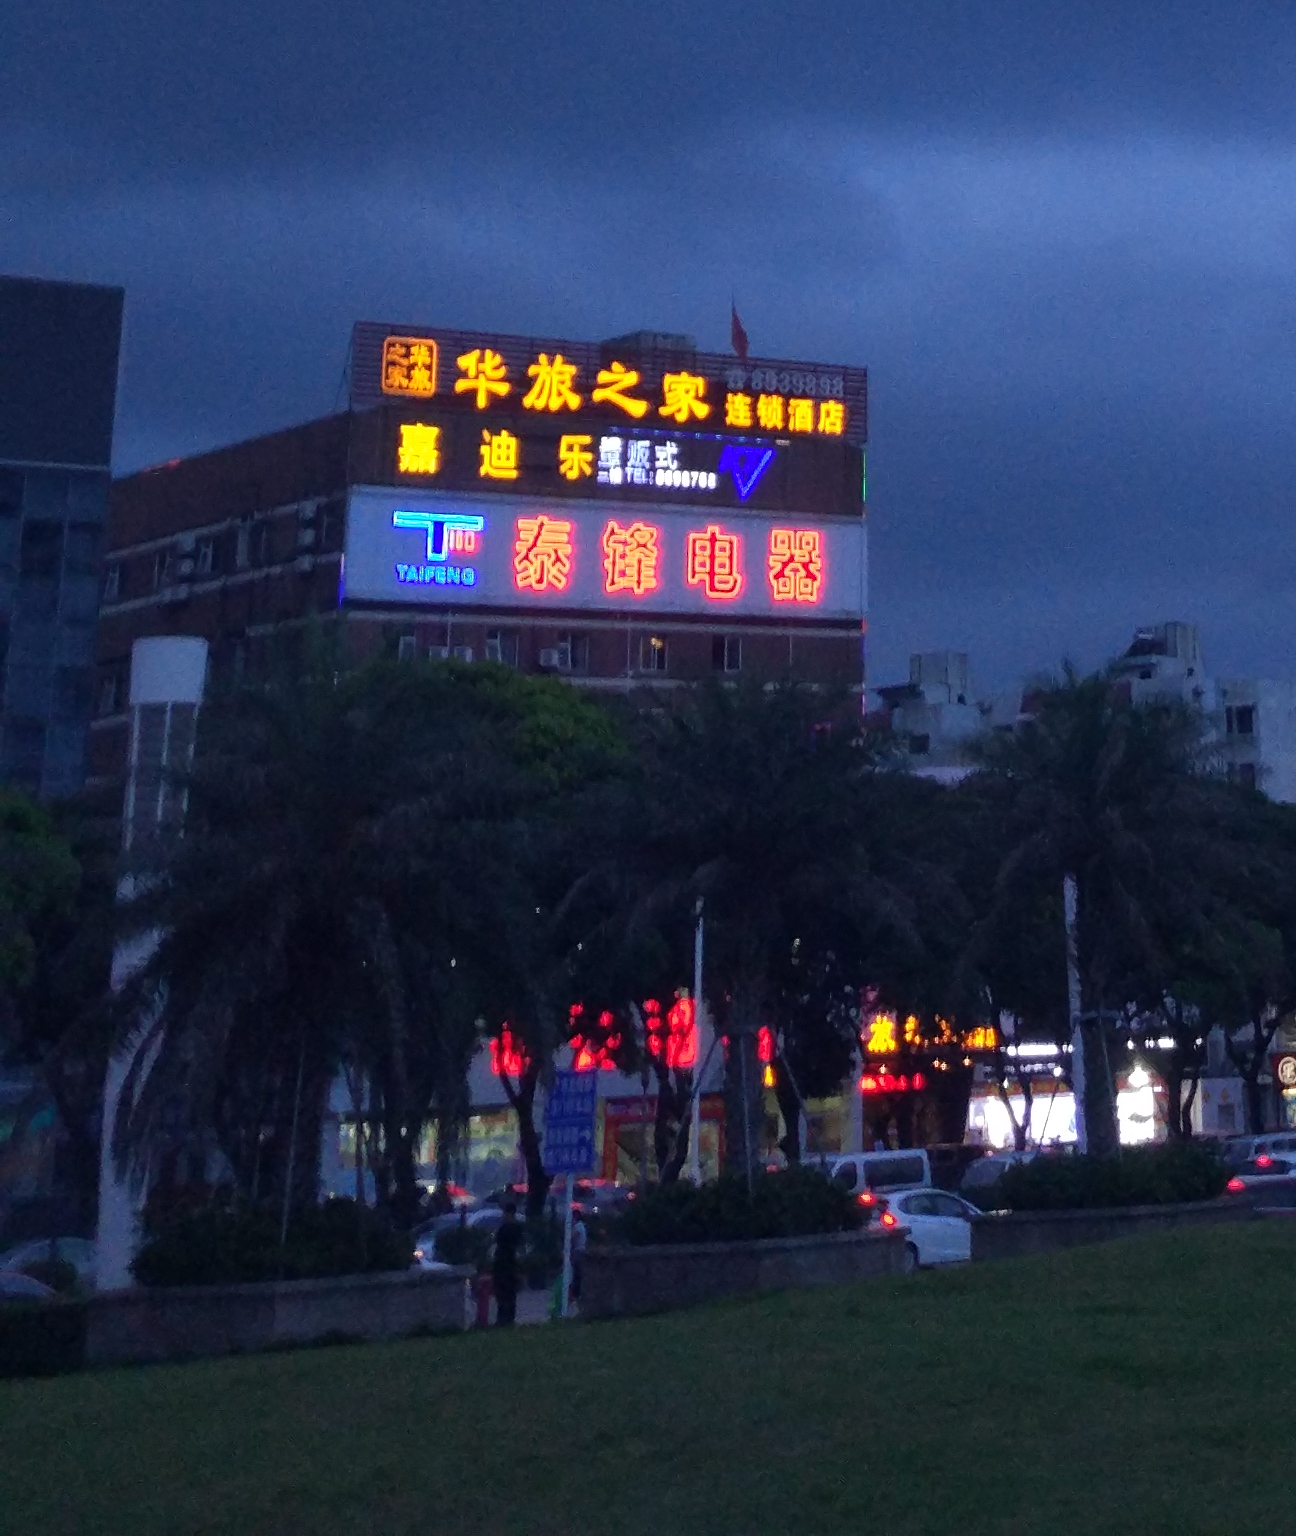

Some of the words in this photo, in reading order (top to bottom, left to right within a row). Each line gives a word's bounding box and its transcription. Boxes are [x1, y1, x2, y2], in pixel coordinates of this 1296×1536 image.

[454, 349, 711, 423] 华旅之家
[725, 392, 845, 436] 连锁酒店
[398, 423, 594, 480] 嘉迪乐
[396, 564, 475, 586] TAIFENG
[513, 514, 824, 603] 泰锋电器
